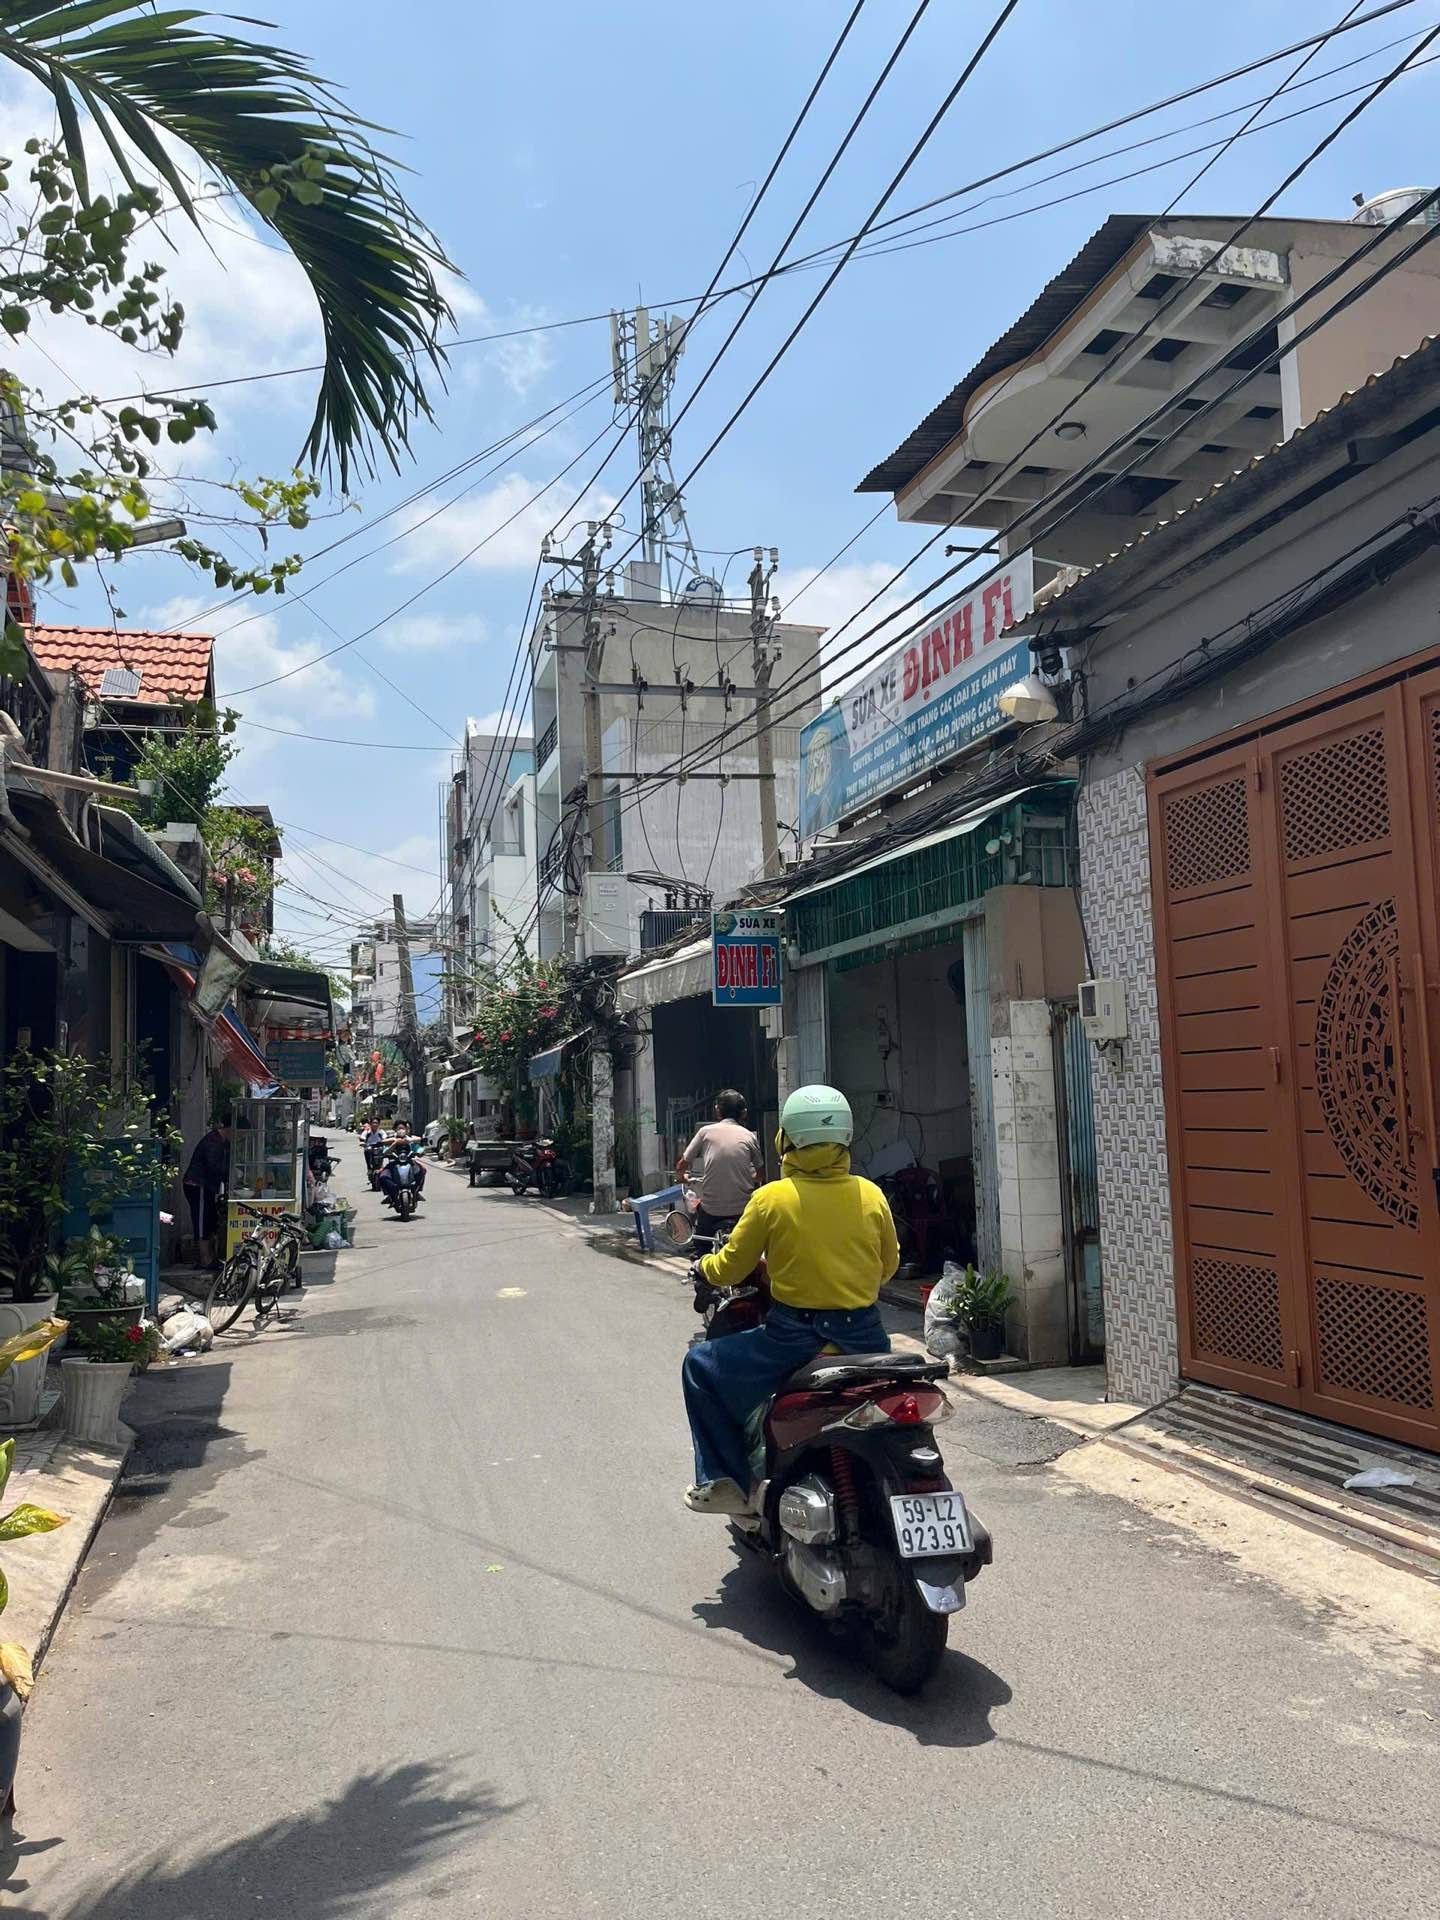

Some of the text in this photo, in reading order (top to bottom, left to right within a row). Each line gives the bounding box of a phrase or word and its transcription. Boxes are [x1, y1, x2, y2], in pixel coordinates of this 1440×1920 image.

[903, 602, 974, 701] ĐỊNH
[879, 668, 897, 711] XE
[971, 679, 980, 697] XE
[971, 722, 984, 737] 035
[986, 712, 1000, 728] 606
[762, 918, 776, 929] XE
[902, 1498, 957, 1524] 59-L2
[902, 1523, 967, 1553] 923.91
